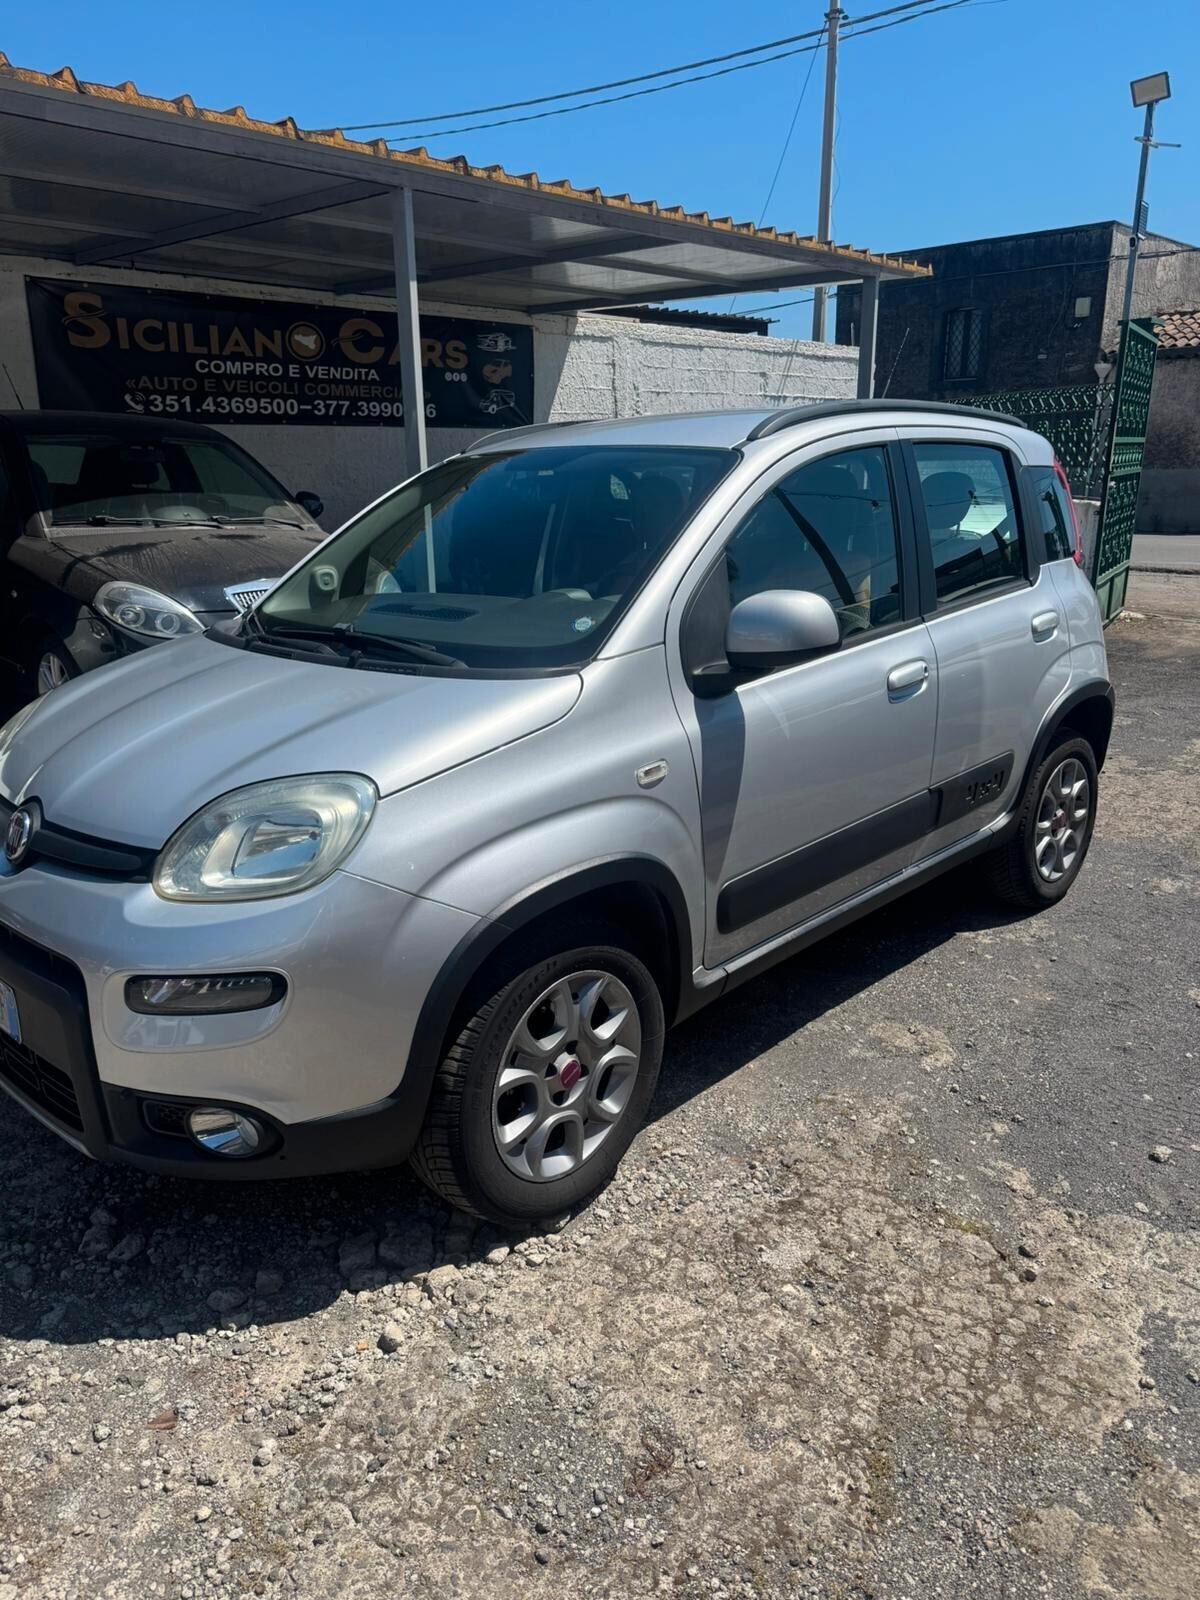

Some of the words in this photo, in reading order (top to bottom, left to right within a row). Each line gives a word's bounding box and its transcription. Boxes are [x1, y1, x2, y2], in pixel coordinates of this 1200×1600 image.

[195, 359, 283, 376] COMPRO
[288, 364, 300, 378] E
[305, 365, 380, 381] VENDITA
[203, 378, 217, 392] E
[222, 379, 299, 395] VEICOLI
[148, 394, 437, 418] 351.4369500-377.39906
